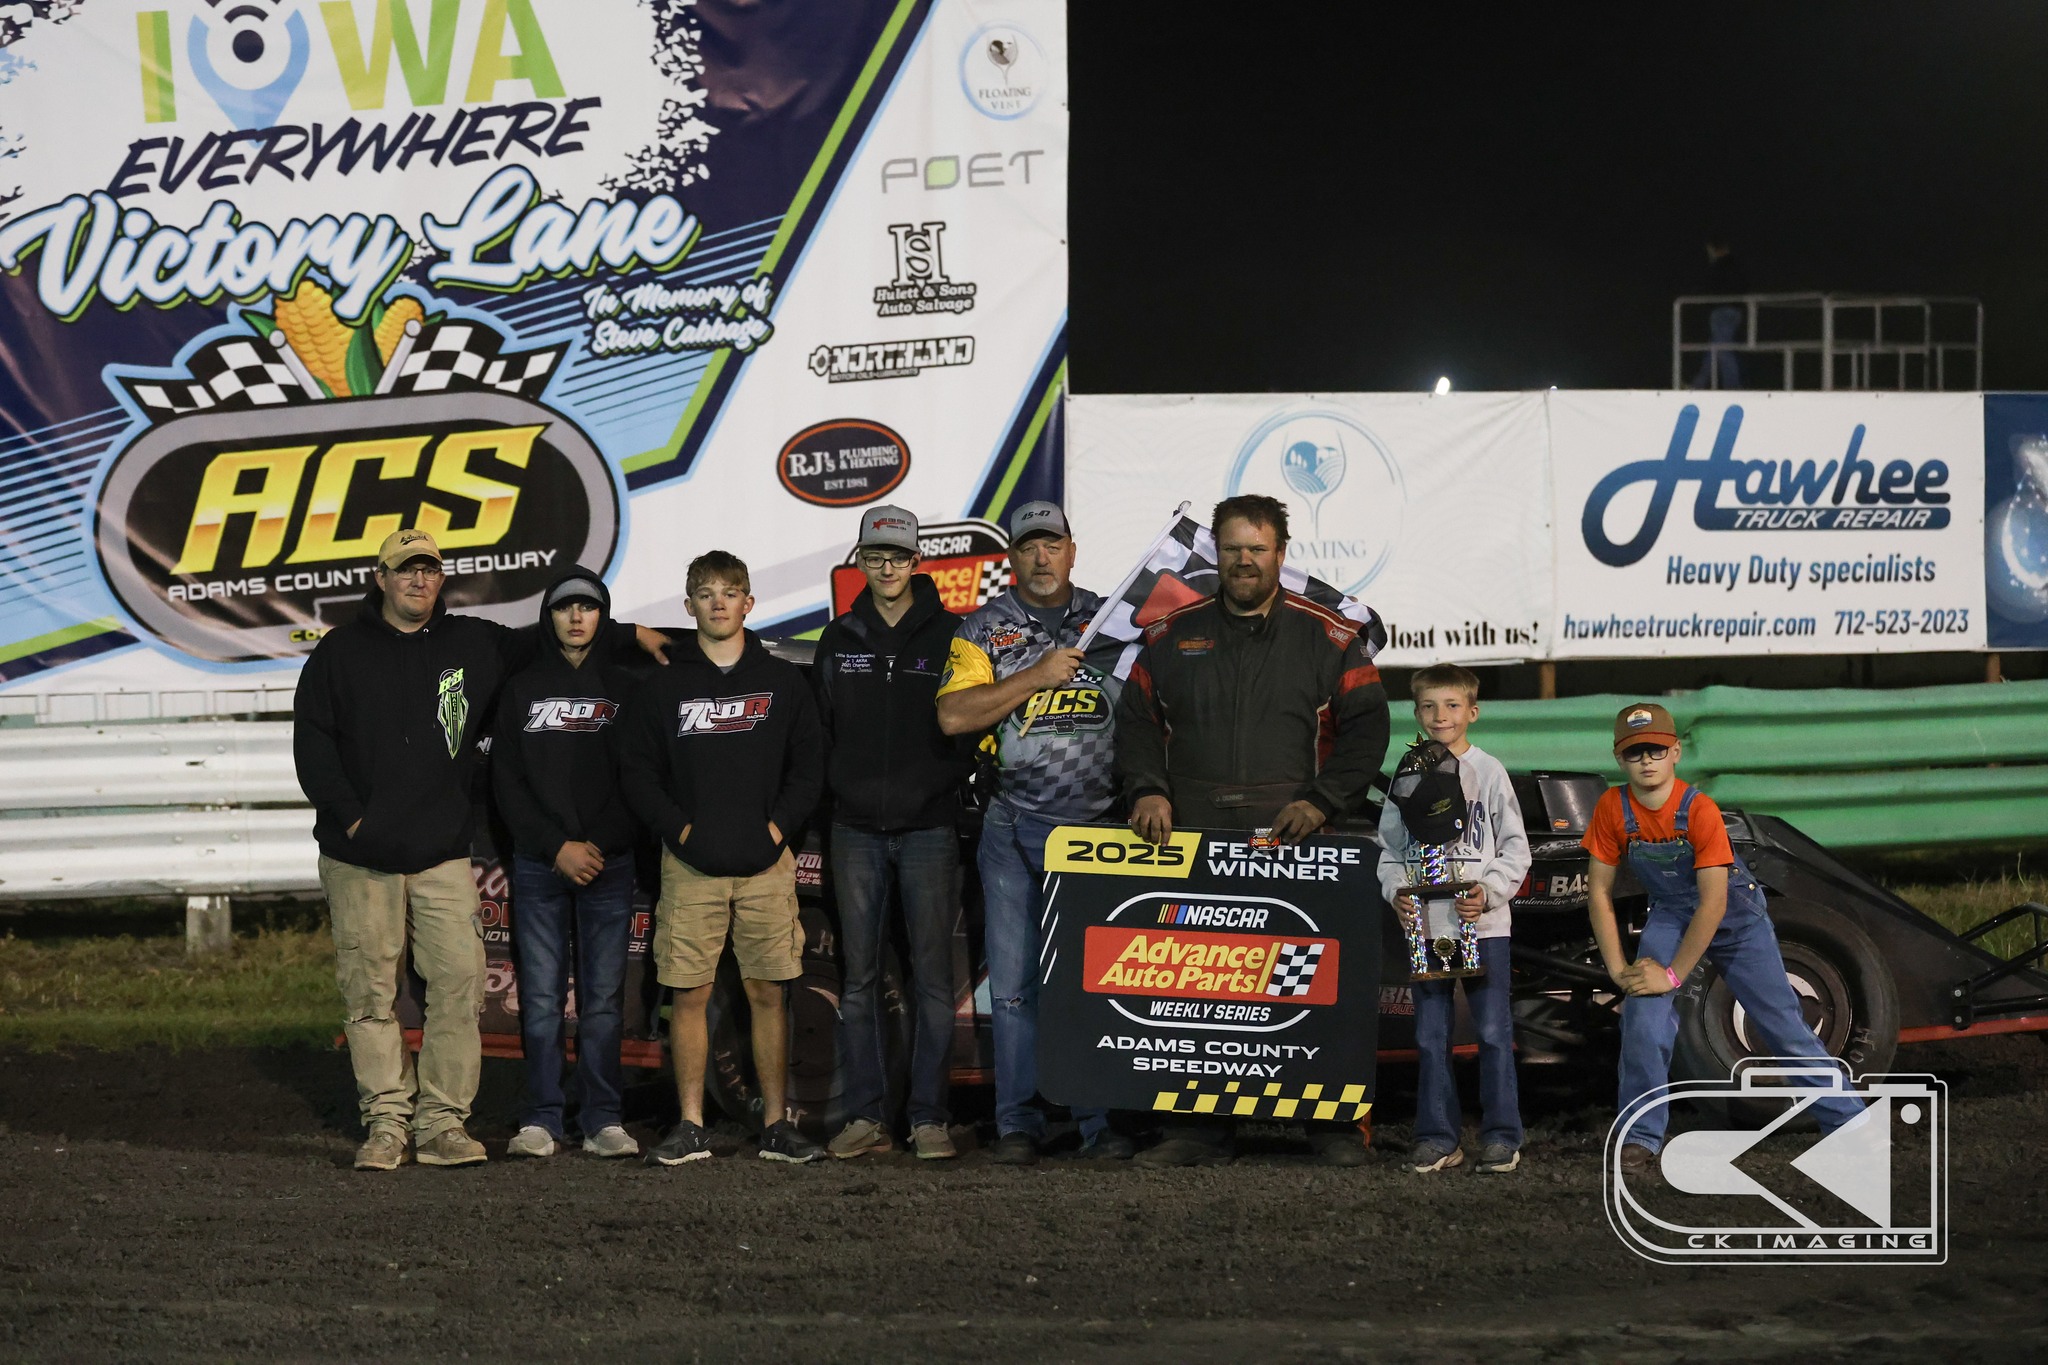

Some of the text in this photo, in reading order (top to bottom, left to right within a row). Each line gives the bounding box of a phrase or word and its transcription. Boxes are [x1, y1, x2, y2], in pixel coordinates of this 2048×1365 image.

[978, 86, 1032, 99] FLOATING
[106, 96, 602, 200] EVERYWHERE
[881, 149, 1045, 194] POET
[0, 164, 700, 322] Victory Lane
[583, 276, 772, 319] In Memory of
[875, 283, 976, 302] Hulett & Sons
[879, 297, 973, 316] Auto Salvage
[591, 315, 770, 354] Steve Cabbage
[838, 444, 899, 460] PLUMBING
[849, 456, 900, 469] HEATING
[824, 479, 845, 491] EST
[1581, 404, 1951, 567] Hawhee
[169, 424, 552, 576] ACS
[1731, 508, 1933, 529] TRUCK REPAIR
[918, 534, 973, 557] ASCAR
[1287, 539, 1367, 560] OATING
[168, 548, 558, 603] ADAMS COUNT EEDWAY
[1666, 553, 1937, 591] Heavy Duty specialists
[1329, 627, 1350, 643] OMP
[1387, 620, 1539, 649] loat with us!
[1563, 608, 1970, 643] hawheetruckrepair.com 712-523-2023
[1066, 840, 1185, 867] 2025
[1207, 859, 1340, 882] WINNER
[1183, 904, 1269, 929] NASCAR
[1117, 934, 1265, 967] Advance
[1098, 962, 1258, 994] Auto Parts
[1149, 1001, 1272, 1022] WEEKLY SERIES
[1096, 1035, 1321, 1060] ADAMS COUNTY
[1132, 1057, 1283, 1078] SPEEDWAY
